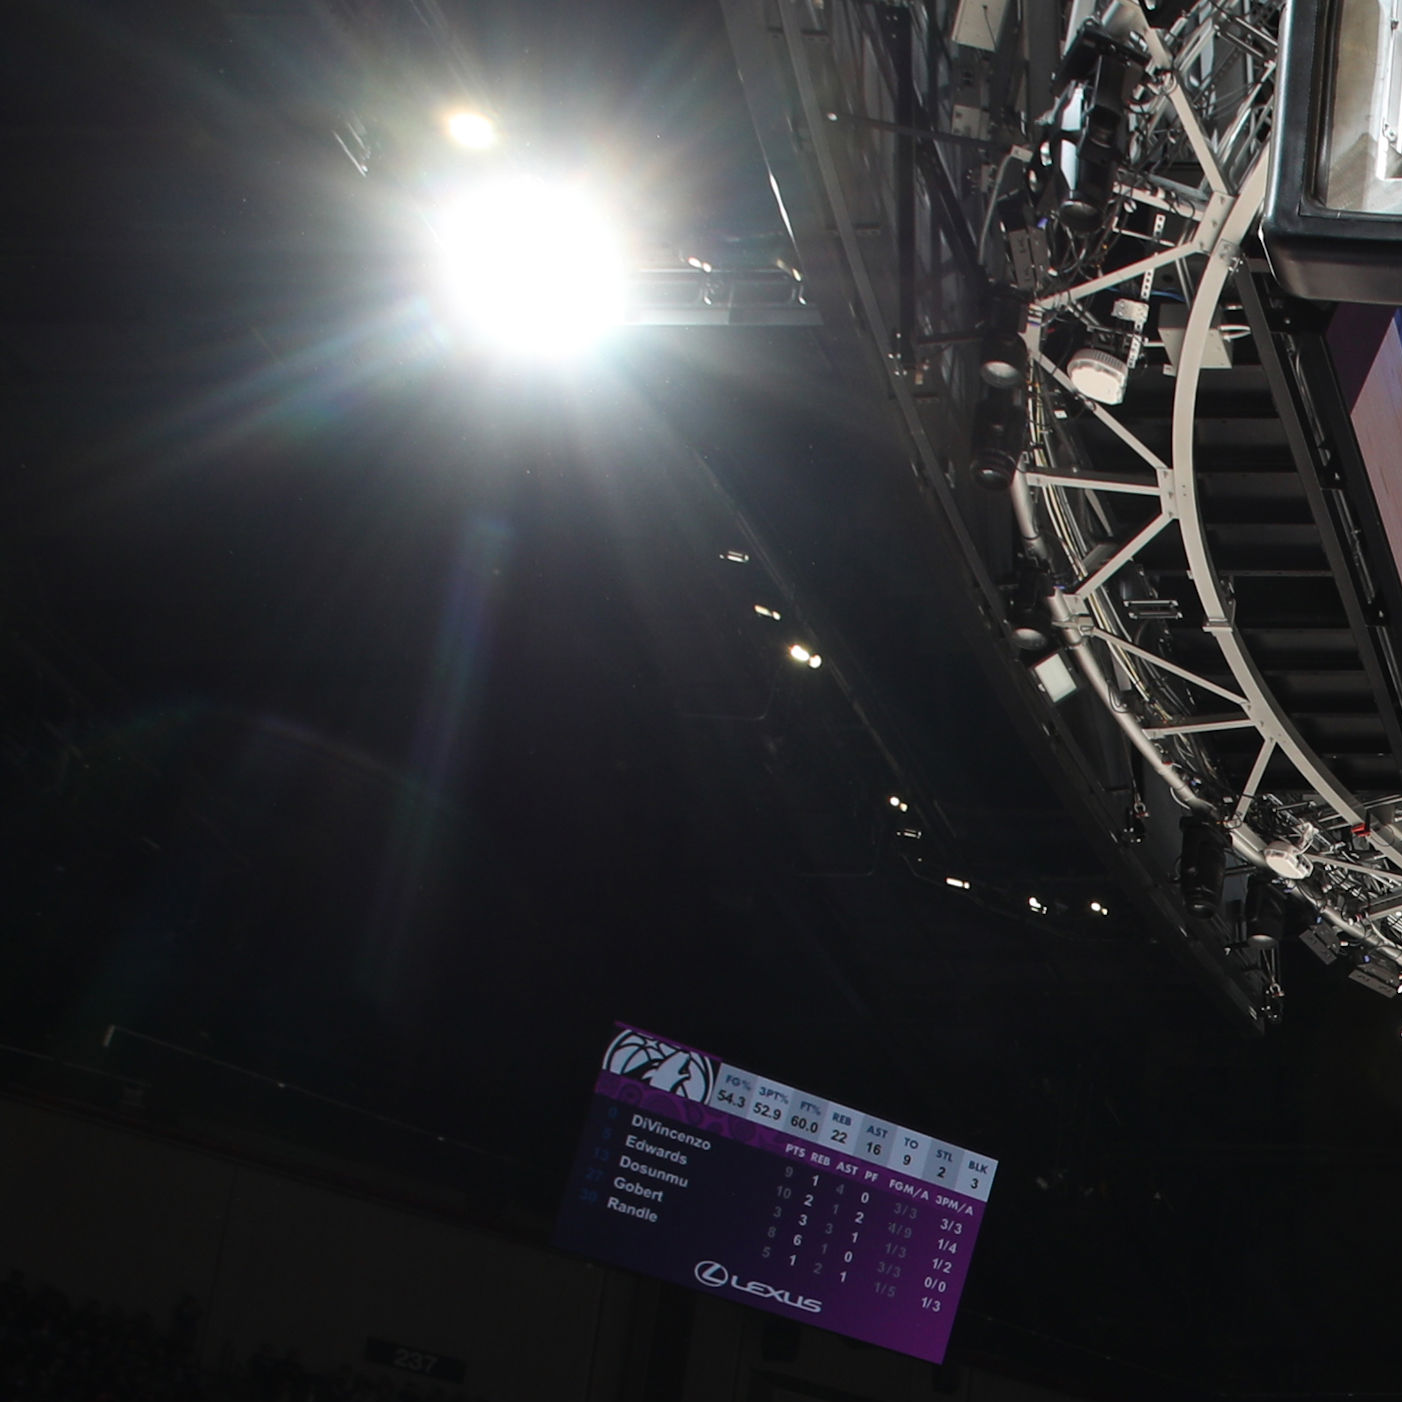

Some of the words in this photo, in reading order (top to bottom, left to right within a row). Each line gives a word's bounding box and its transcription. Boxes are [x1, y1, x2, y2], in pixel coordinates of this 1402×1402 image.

[631, 1114, 711, 1150] DiVincenzo
[717, 1089, 746, 1109] 54.3
[753, 1102, 782, 1120] 52.9
[790, 1115, 818, 1133] 60.0
[831, 1129, 848, 1144] 22
[866, 1142, 882, 1156] 16
[903, 1155, 911, 1166] 9
[937, 1167, 946, 1178] 2
[971, 1178, 979, 1190] 3
[625, 1134, 688, 1165] Edwards
[619, 1155, 688, 1188] Dosunmu
[785, 1143, 806, 1158] PTS
[810, 1152, 831, 1167] REB
[836, 1162, 859, 1176] AST
[864, 1171, 879, 1183] PF
[889, 1179, 929, 1201] FGM/A
[935, 1195, 974, 1216] 3PM/A
[613, 1176, 664, 1202] Gobert
[606, 1196, 658, 1223] Randle
[730, 1275, 823, 1313] LEXUS
[394, 1347, 439, 1375] 237
